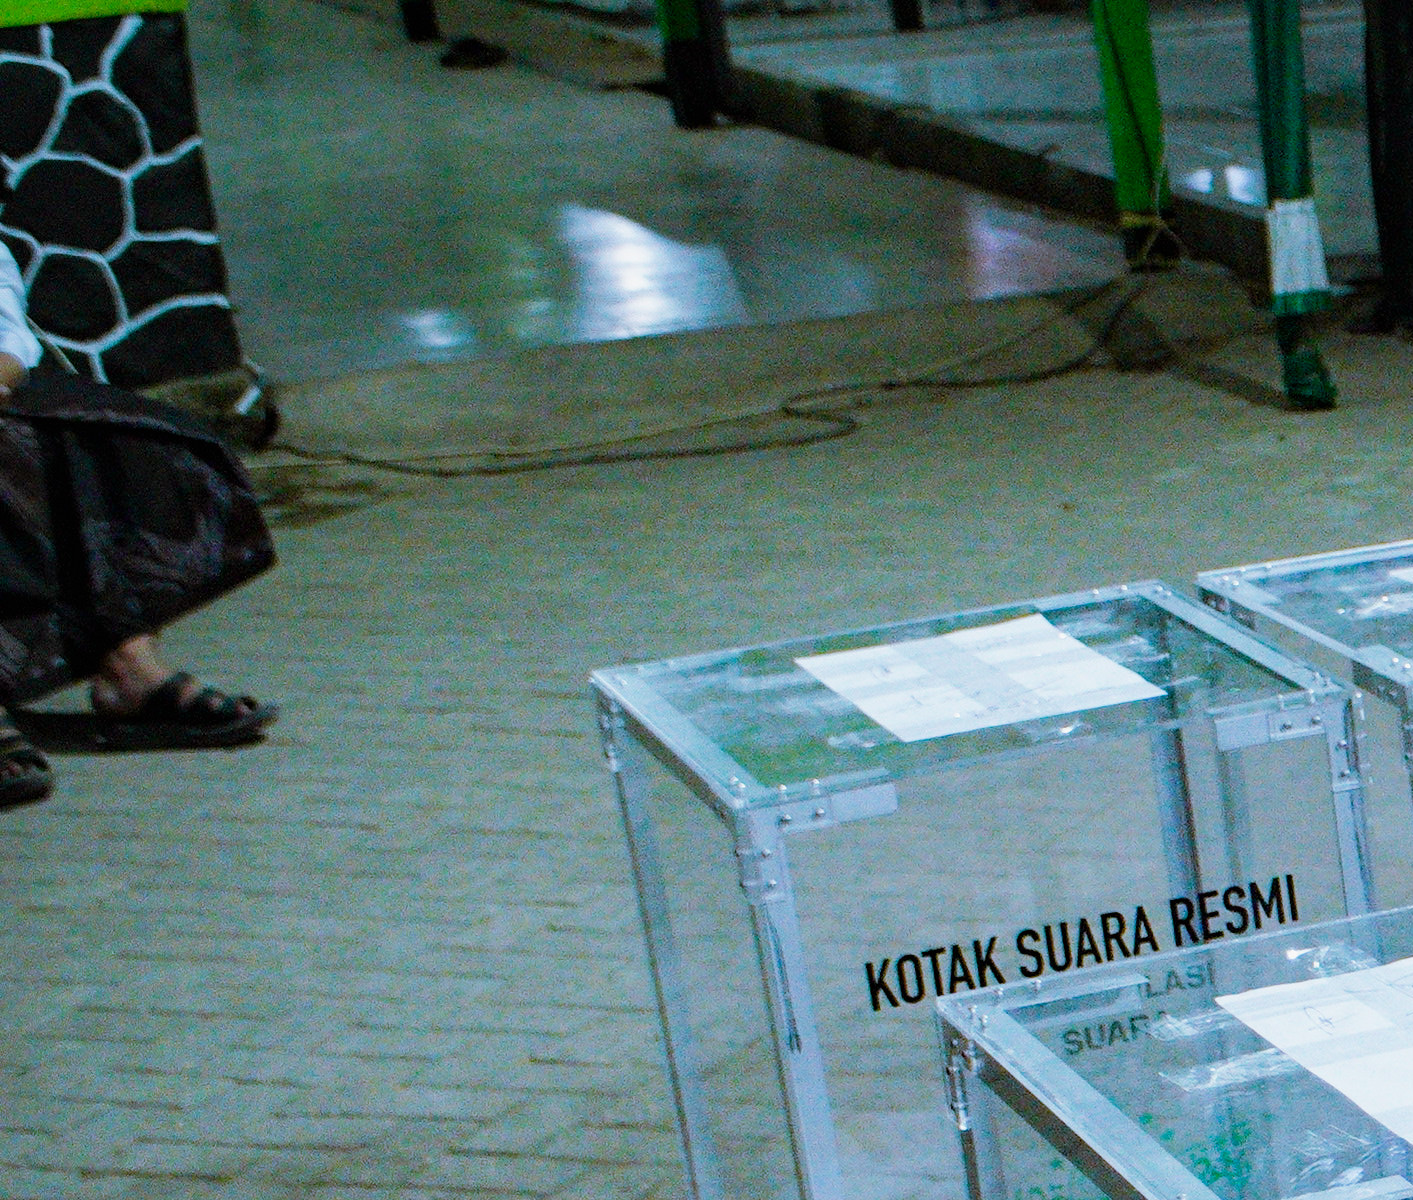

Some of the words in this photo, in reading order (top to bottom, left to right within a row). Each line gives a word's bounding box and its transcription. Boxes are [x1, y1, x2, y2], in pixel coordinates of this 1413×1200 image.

[865, 936, 1006, 1011] KOTAK
[1017, 906, 1158, 977] SUARA
[1171, 874, 1299, 946] RESMI
